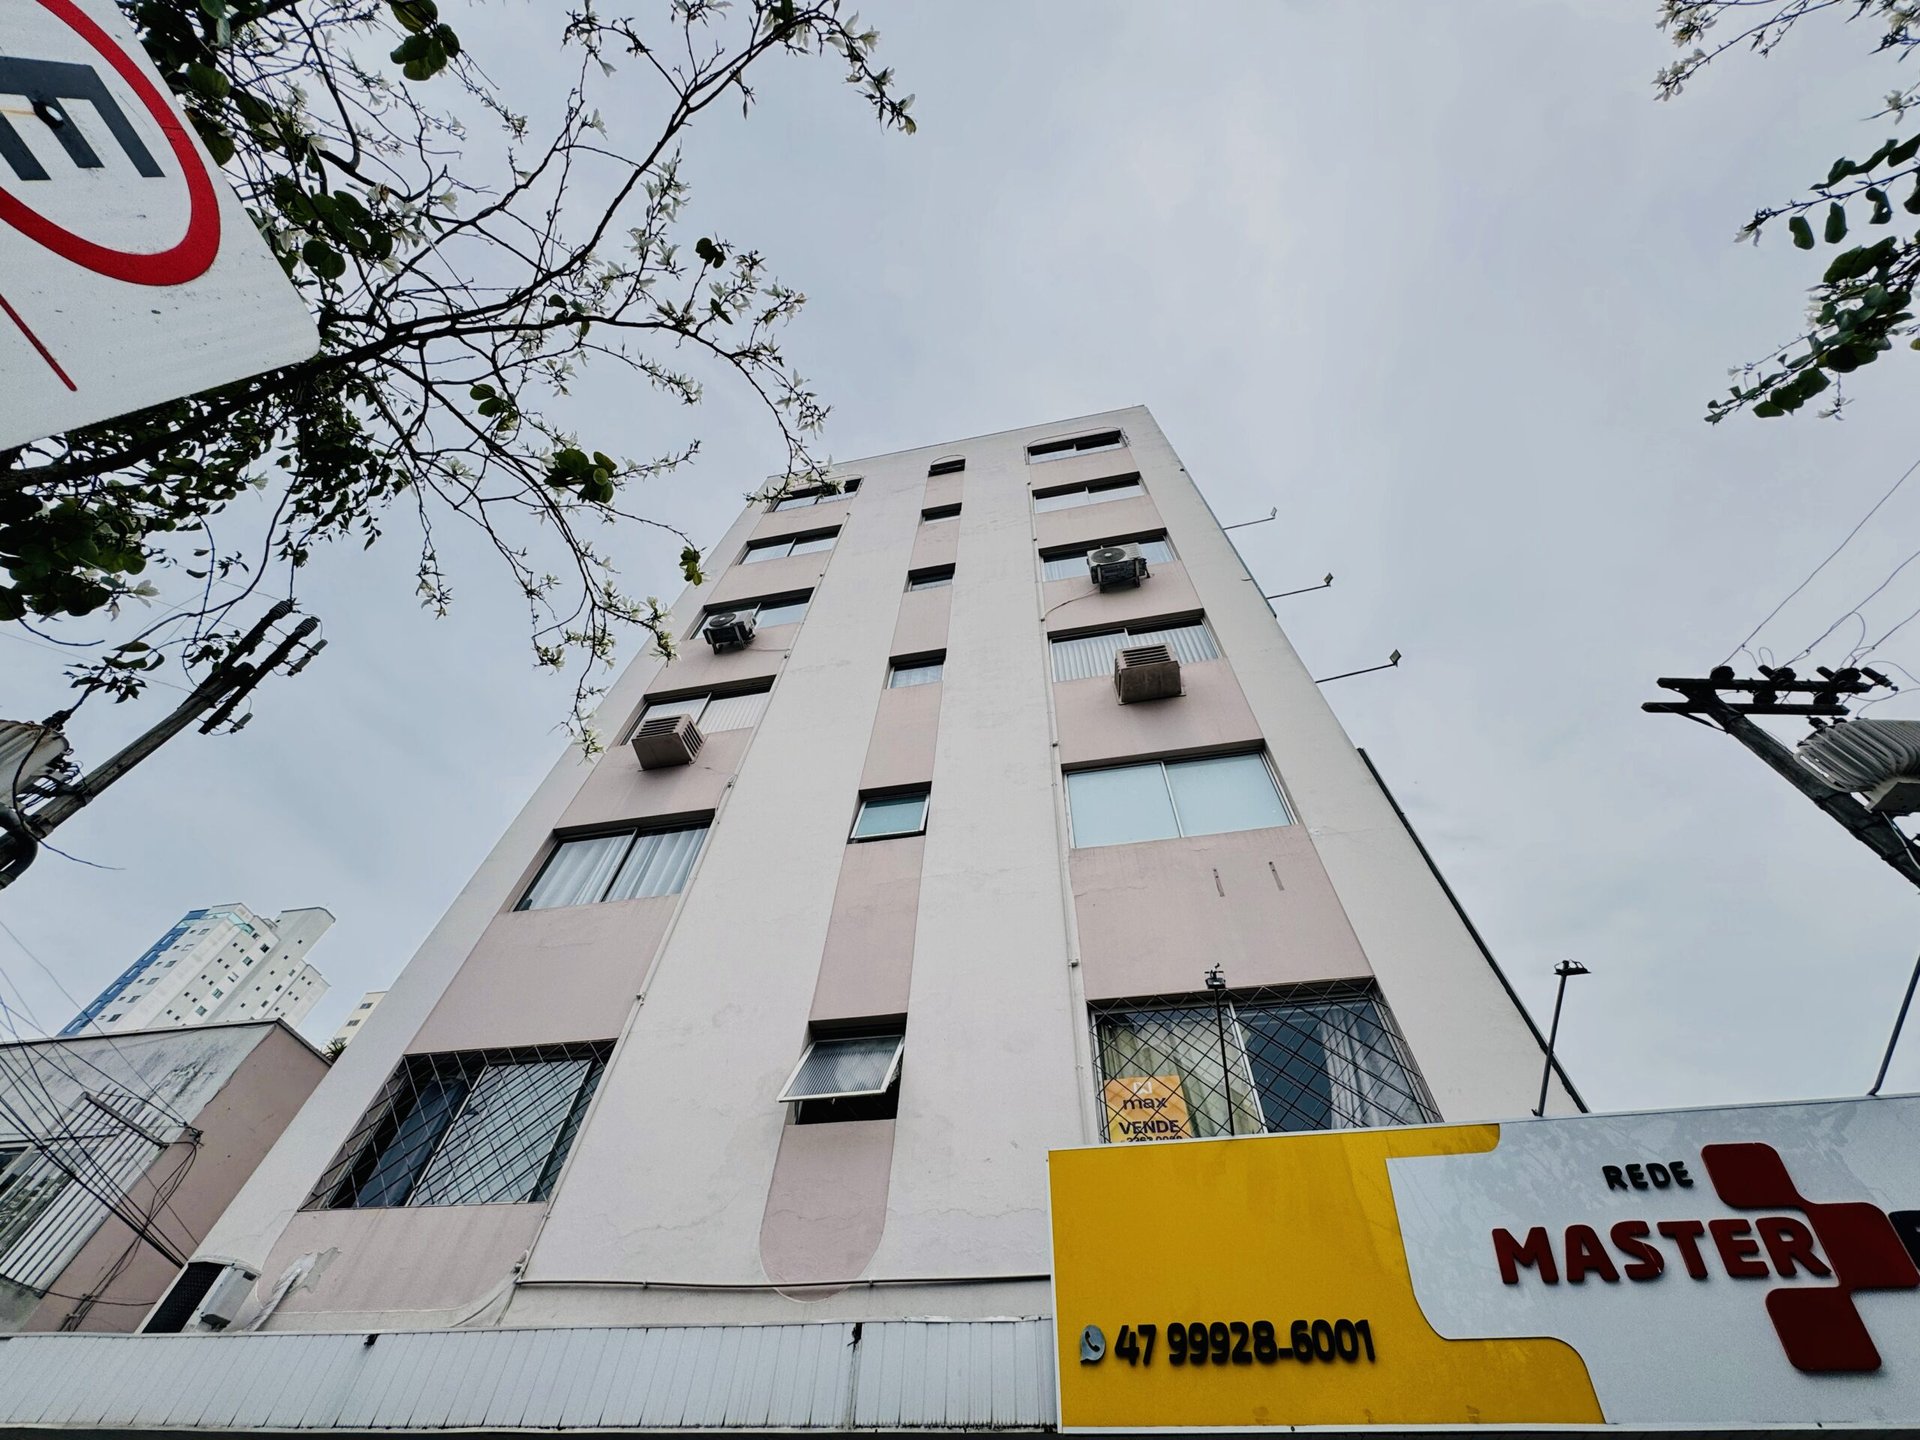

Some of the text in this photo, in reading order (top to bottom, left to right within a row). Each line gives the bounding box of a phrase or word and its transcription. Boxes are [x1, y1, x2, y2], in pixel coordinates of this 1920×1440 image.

[1123, 1097, 1168, 1110] max
[1119, 1120, 1181, 1135] VENDE
[1602, 1160, 1694, 1190] REDE
[1491, 1216, 1831, 1284] MASTER
[1114, 1319, 1376, 1366] 47 99928-6001
